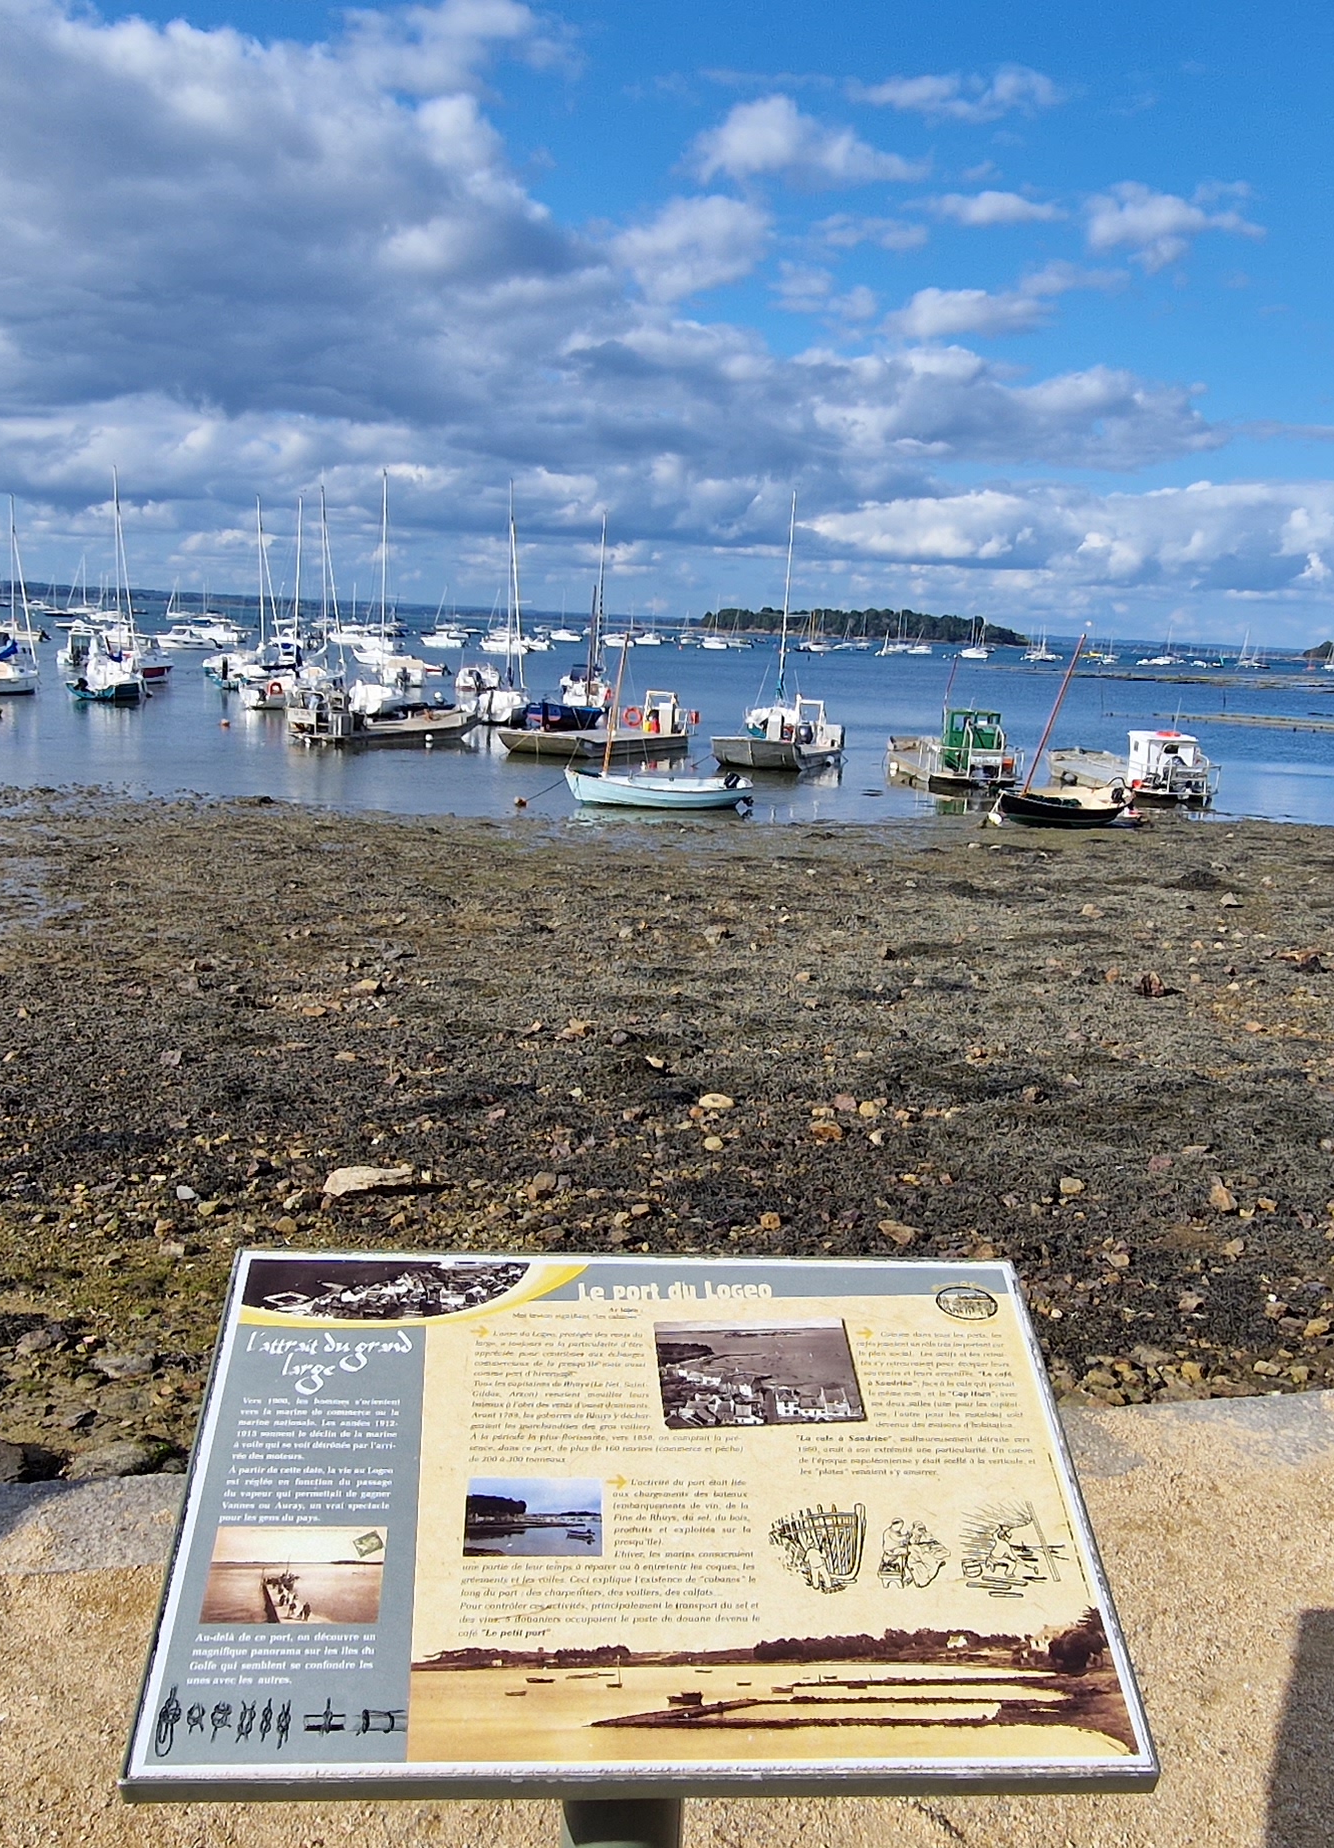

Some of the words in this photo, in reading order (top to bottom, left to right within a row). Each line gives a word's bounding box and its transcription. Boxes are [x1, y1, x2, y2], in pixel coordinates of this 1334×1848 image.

[578, 1282, 605, 1301] Le
[613, 1282, 661, 1301] port
[668, 1281, 697, 1300] du
[704, 1280, 772, 1299] Logeo
[323, 1332, 350, 1353] du
[339, 1330, 413, 1372] grand
[282, 1352, 336, 1395] large
[195, 1632, 234, 1642] Au-delà
[238, 1632, 251, 1641] de
[269, 1633, 293, 1644] port,
[314, 1632, 359, 1641] découvre
[192, 1646, 247, 1658] magnifique
[250, 1648, 301, 1658] panorama
[304, 1648, 321, 1656] sur
[324, 1646, 338, 1655] les
[189, 1660, 217, 1670] Golfe
[221, 1661, 237, 1673] qui
[241, 1660, 286, 1670] semblent
[305, 1660, 355, 1670] confondre
[359, 1660, 373, 1669] les
[238, 1674, 253, 1684] les
